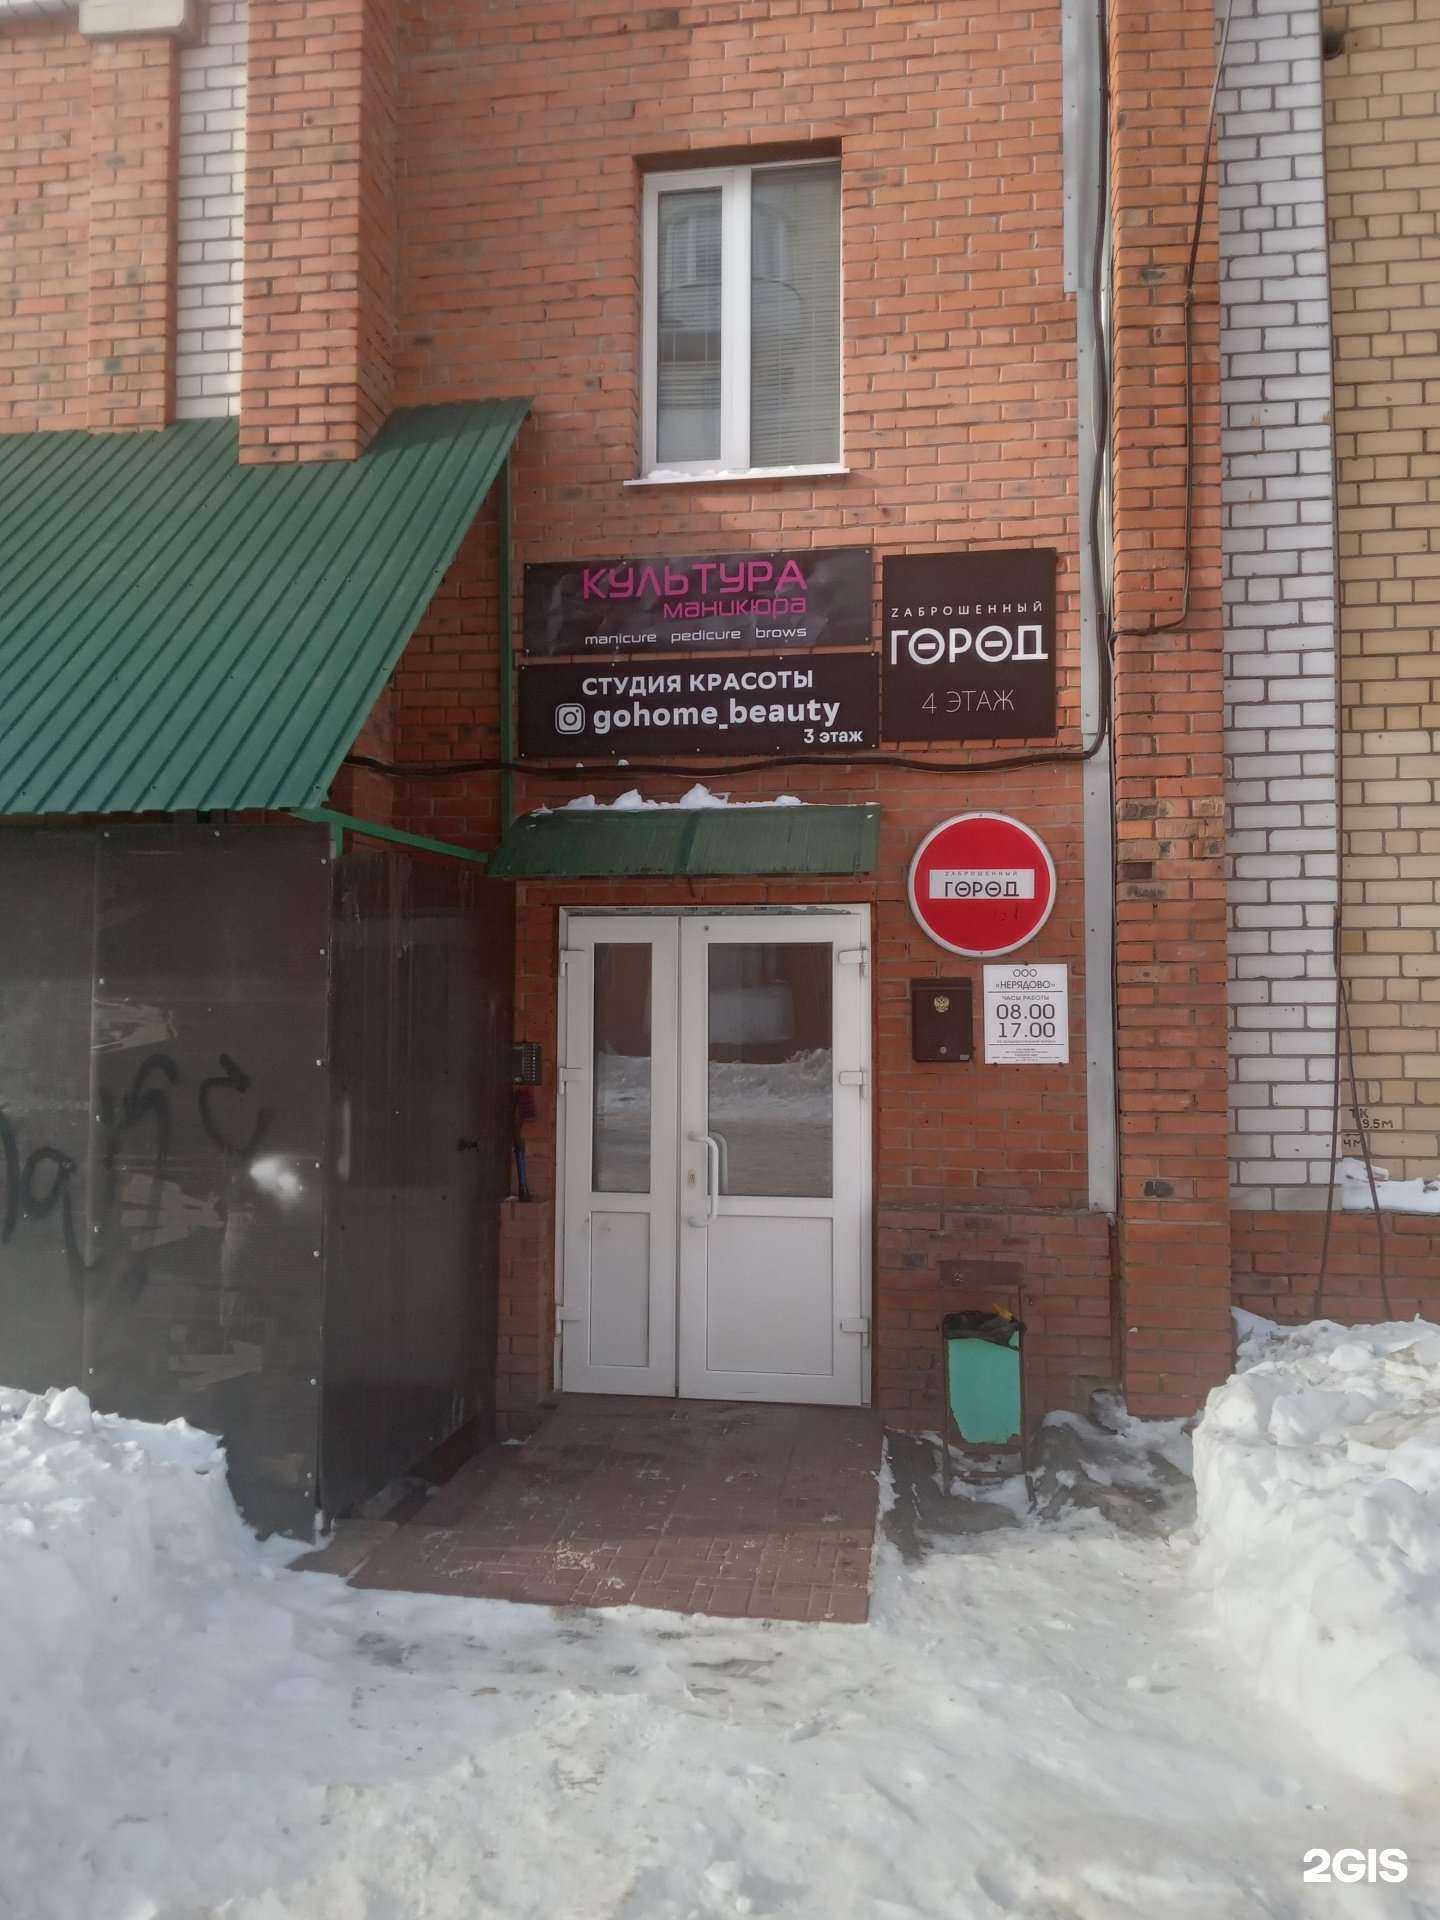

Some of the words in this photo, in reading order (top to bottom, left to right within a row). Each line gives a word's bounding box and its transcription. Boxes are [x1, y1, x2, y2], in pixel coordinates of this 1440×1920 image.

[583, 559, 808, 599] КУЛЬТУРА
[585, 632, 657, 645] manicure
[671, 628, 741, 642] pedicure
[756, 627, 807, 639] brows
[891, 624, 1049, 665] ГОРОД
[582, 675, 682, 697] СТУДИЯ
[690, 670, 814, 692] КРАСОТЫ
[921, 691, 937, 714] 4
[946, 689, 1015, 713] ЭТАЖ
[593, 698, 841, 734] gohome_beauty
[804, 729, 814, 743] 3
[819, 729, 863, 743] этаж
[945, 881, 1020, 897] ГОРОД
[1013, 968, 1037, 977] ООО
[996, 1003, 1055, 1020] 08.00
[998, 1022, 1056, 1038] 17.00
